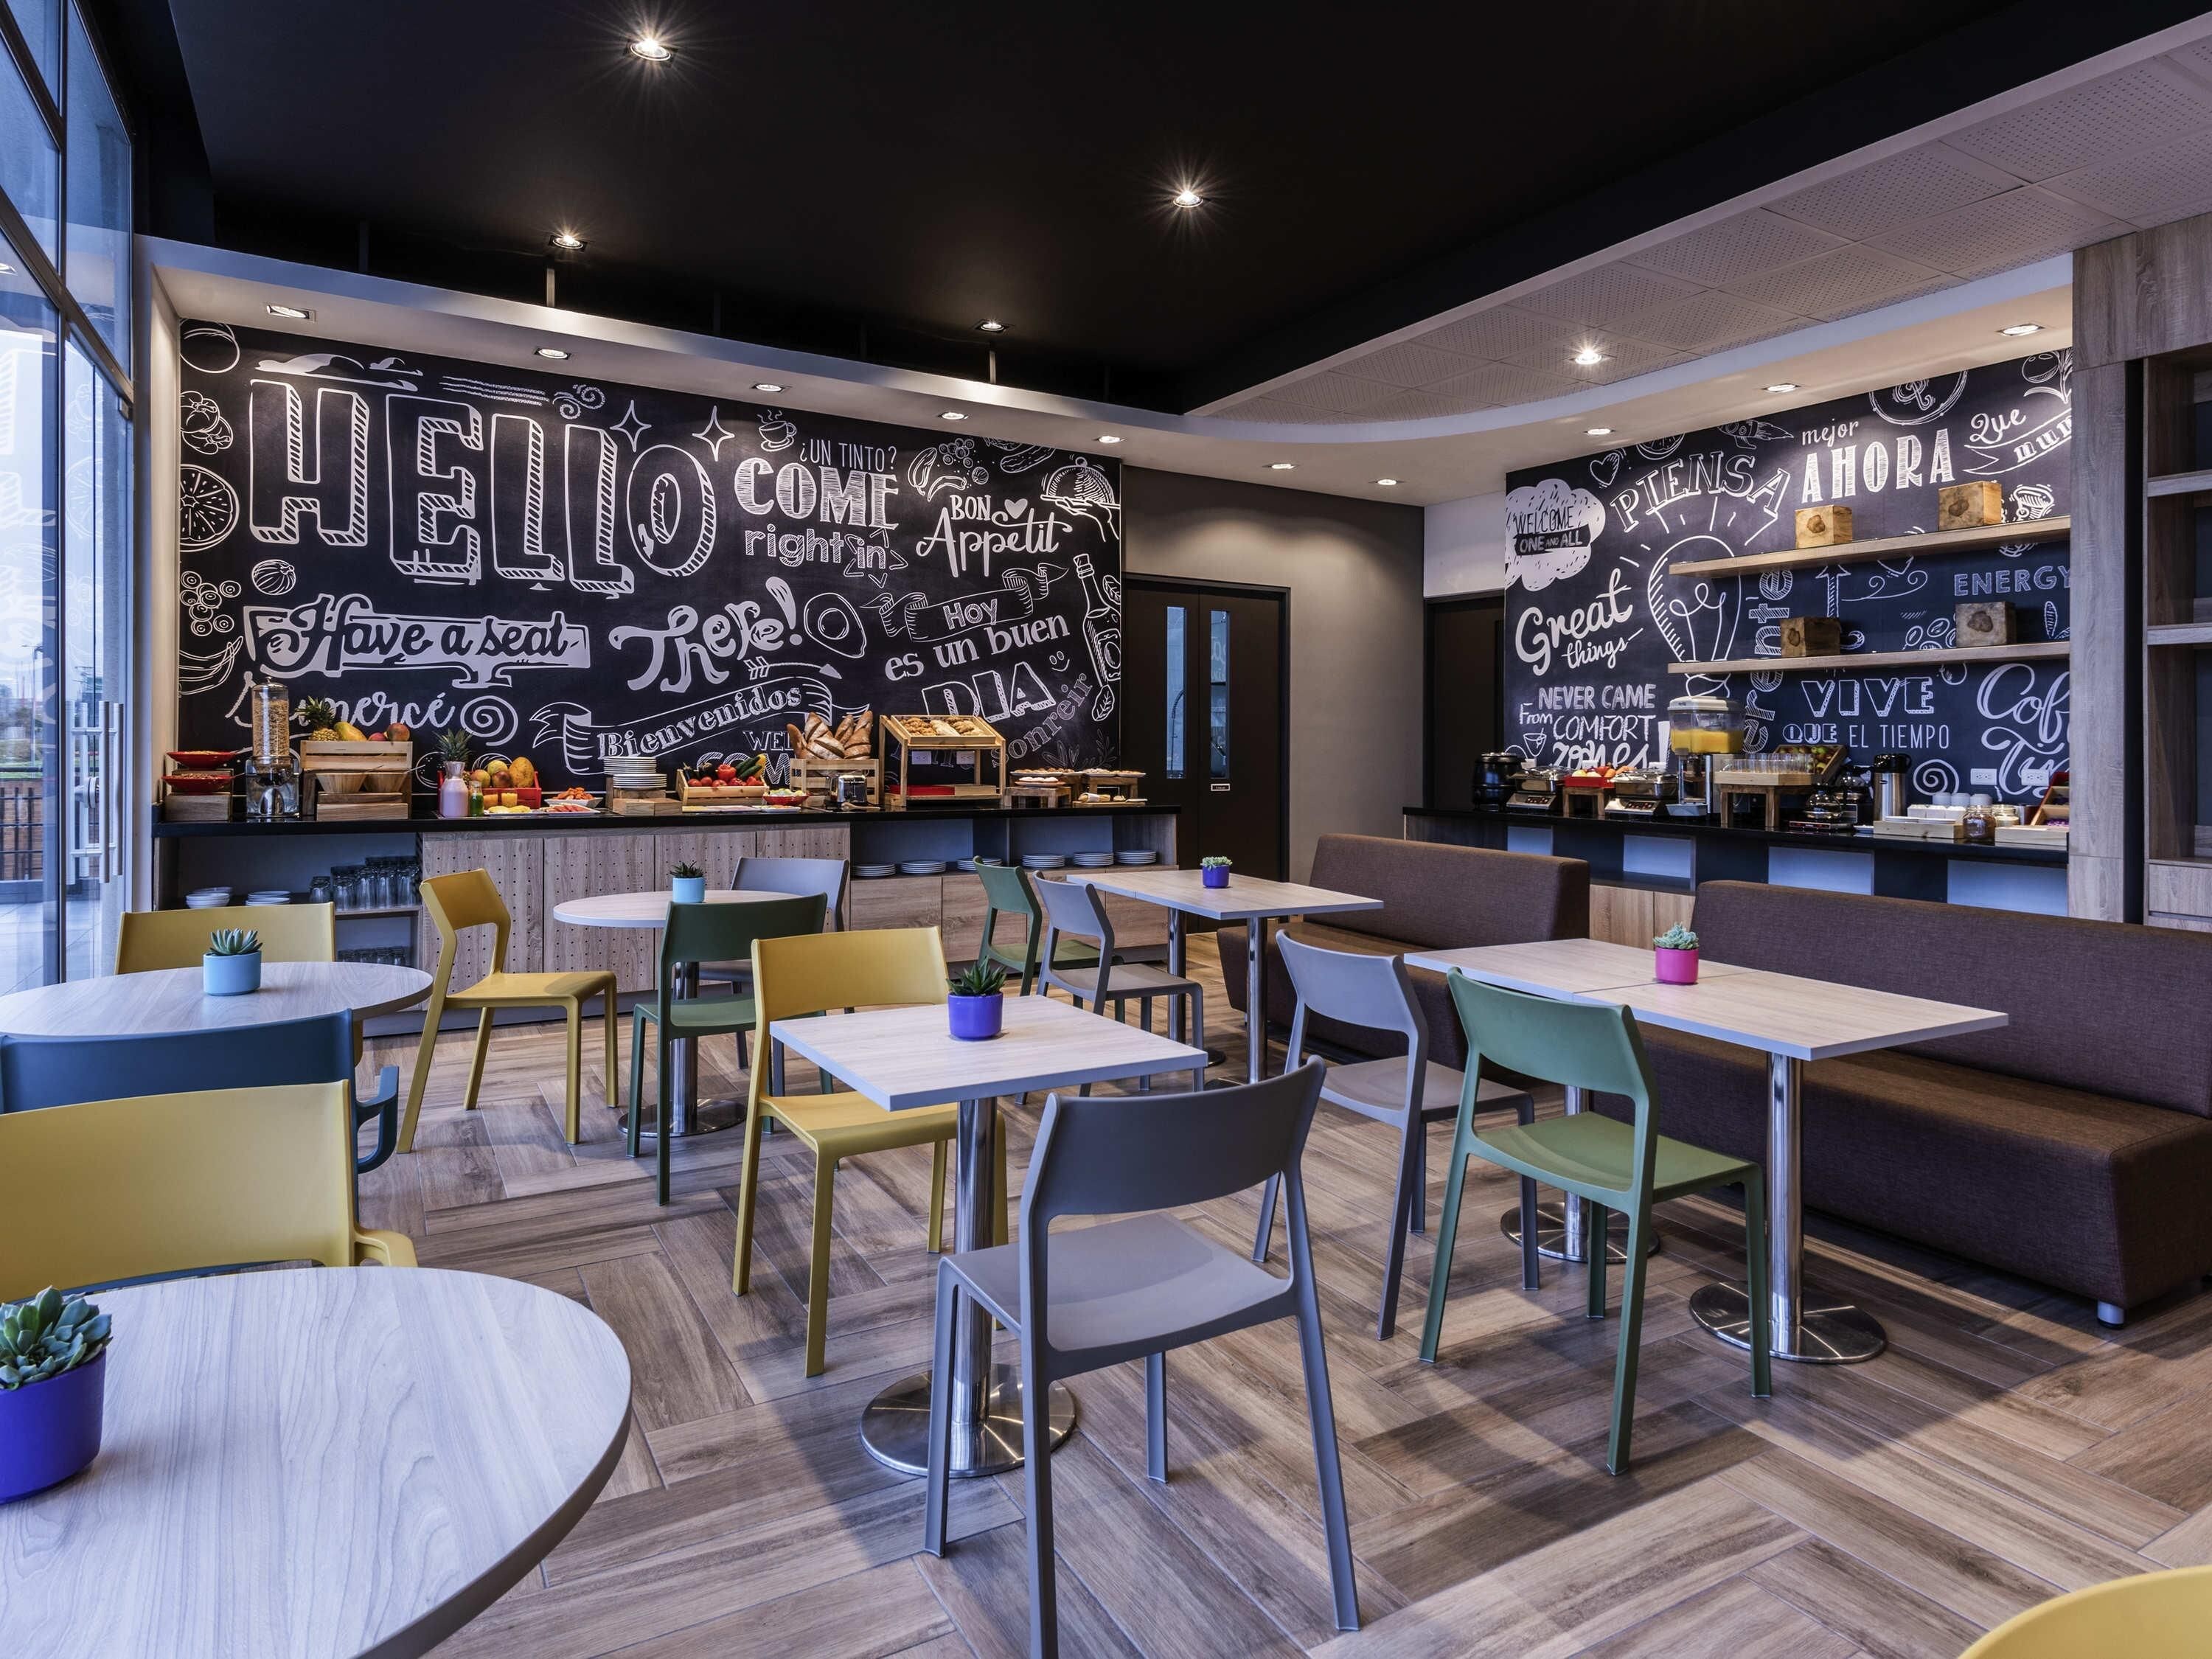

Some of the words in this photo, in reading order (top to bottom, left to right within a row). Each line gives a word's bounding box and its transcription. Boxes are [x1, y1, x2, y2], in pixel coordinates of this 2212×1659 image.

[1802, 418, 1859, 447] mejor
[1969, 408, 2026, 445] Que
[800, 439, 831, 465] ¿UN
[838, 442, 897, 472] TINTO?
[1801, 428, 1955, 504] AHORA
[250, 379, 718, 594] HELLO
[734, 457, 899, 530] COME
[1610, 451, 1791, 533] PIENSA
[949, 495, 992, 521] BON
[1513, 506, 1573, 534] WELCOME
[745, 524, 844, 567] right
[858, 538, 886, 568] in
[916, 507, 1073, 578] Appetit
[1520, 536, 1545, 553] ONE
[1545, 537, 1559, 548] AND
[1560, 530, 1583, 548] ALL
[258, 597, 434, 670] Have
[441, 625, 473, 655] a
[475, 612, 568, 656] seat
[608, 576, 803, 693] There!
[1515, 568, 1634, 676] Great
[885, 653, 925, 681] es
[933, 638, 980, 668] un
[984, 614, 1071, 655] buen
[1562, 637, 1628, 669] things
[922, 661, 1057, 723] DIA
[1539, 686, 1596, 710] NEVER
[1601, 684, 1657, 709] CAME
[1801, 677, 1935, 718] VIVE
[597, 686, 802, 760] Bienvenidos
[1519, 703, 1553, 724] From
[1553, 715, 1656, 741] COMFORT
[1782, 723, 1838, 744] QUE
[1849, 725, 1868, 748] EL
[1879, 724, 1950, 748] TIEMPO
